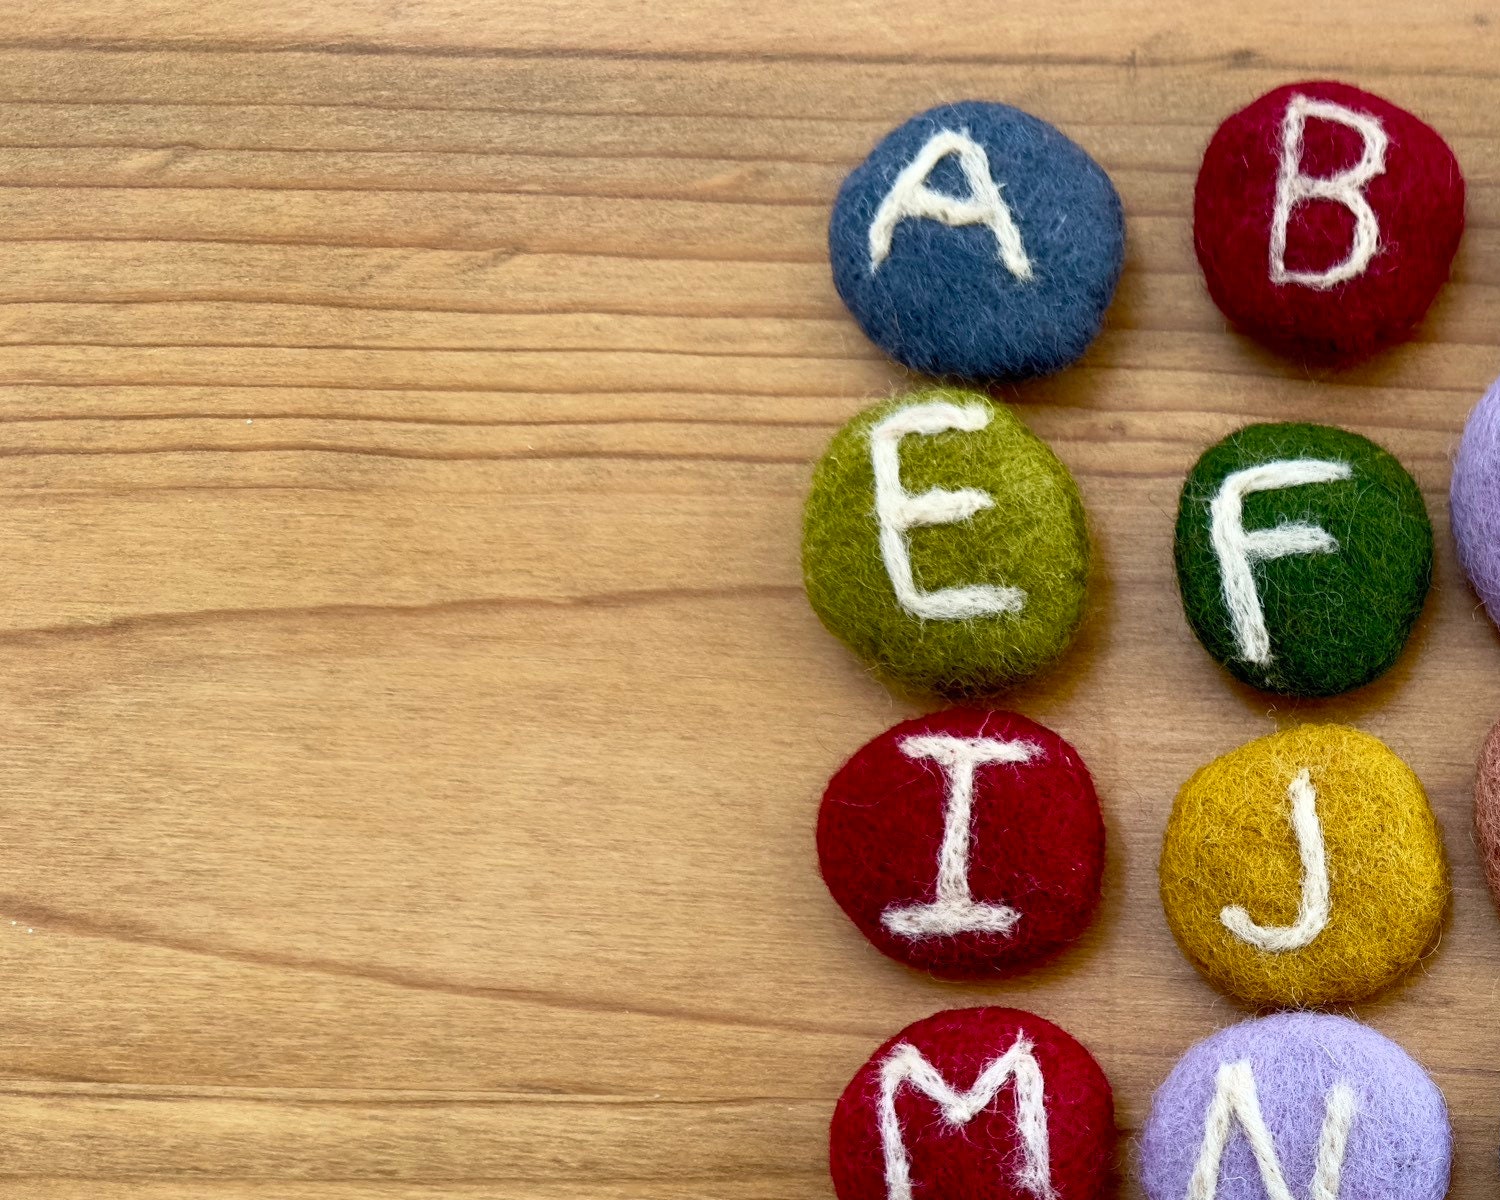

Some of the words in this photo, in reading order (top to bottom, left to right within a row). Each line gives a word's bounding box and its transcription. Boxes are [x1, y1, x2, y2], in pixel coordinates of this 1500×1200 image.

[868, 129, 1033, 279] A
[1269, 97, 1388, 287] B
[868, 400, 1026, 617] E
[1210, 460, 1352, 661] F
[882, 737, 1038, 933] I
[1221, 773, 1330, 949] J
